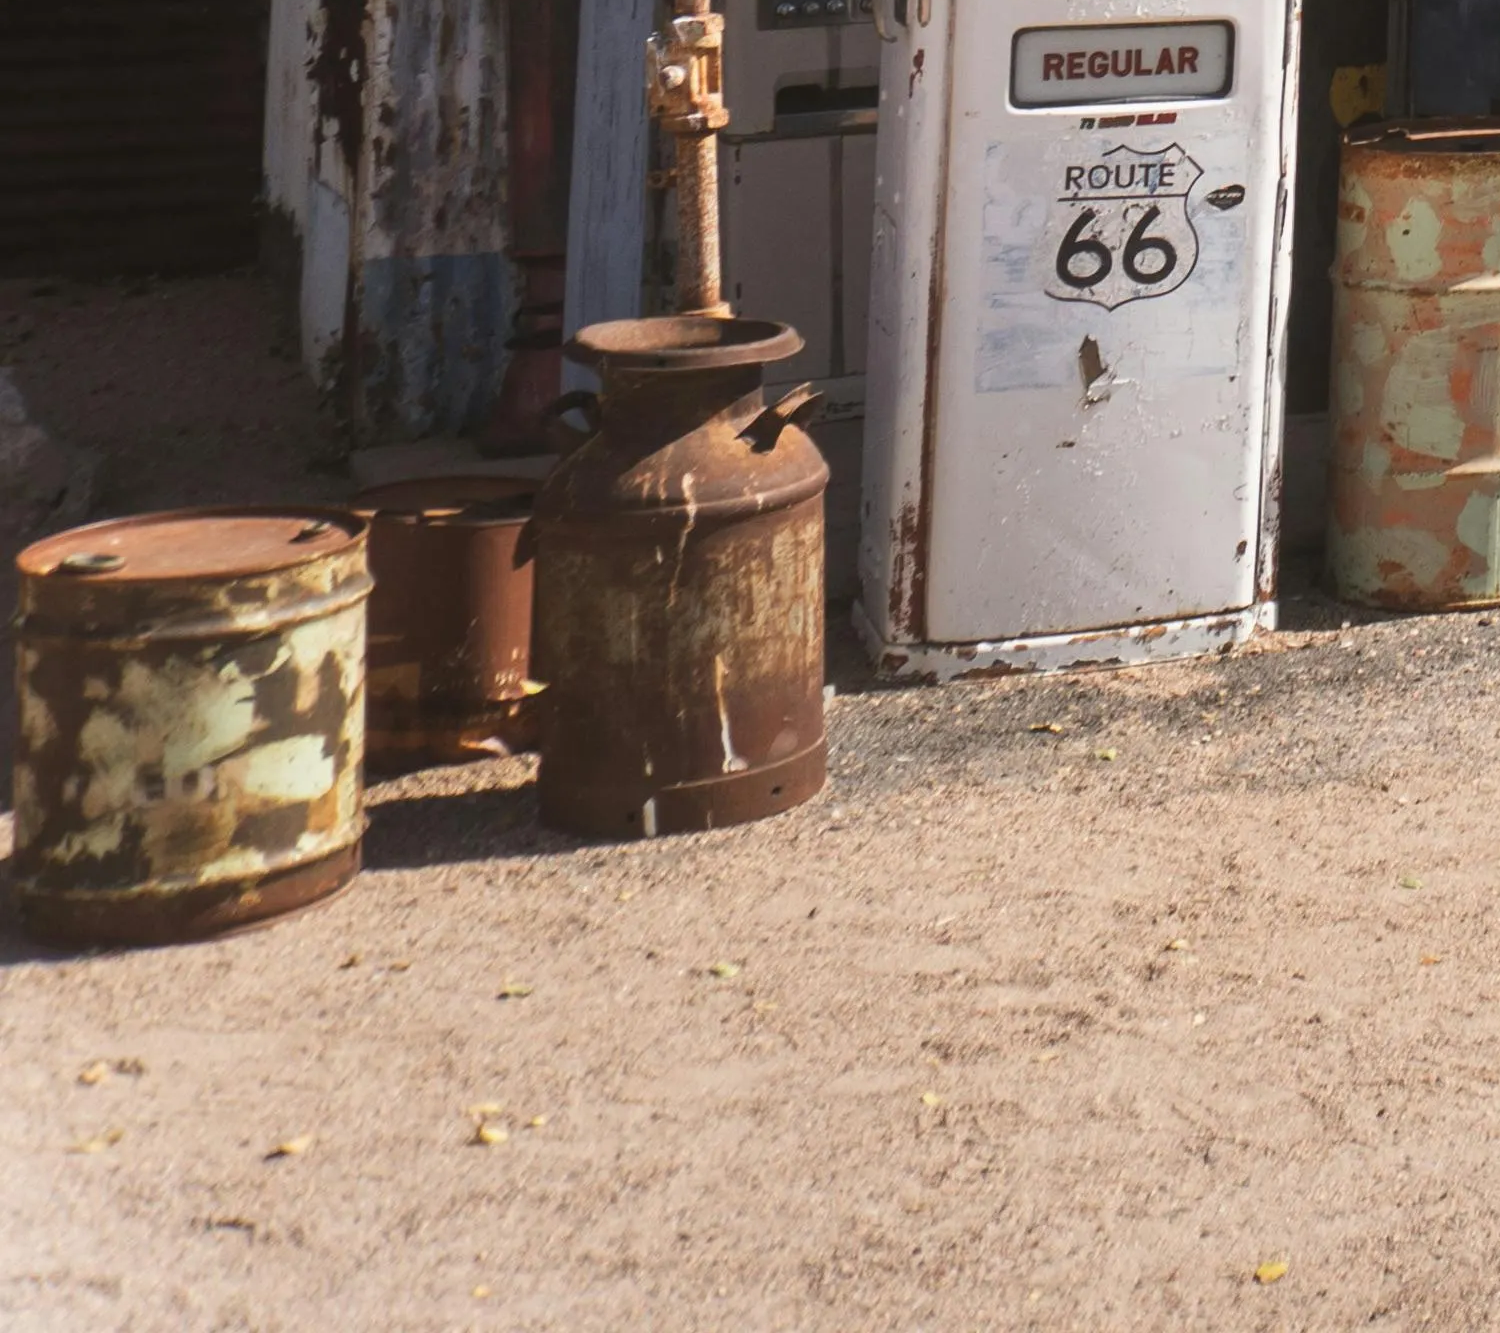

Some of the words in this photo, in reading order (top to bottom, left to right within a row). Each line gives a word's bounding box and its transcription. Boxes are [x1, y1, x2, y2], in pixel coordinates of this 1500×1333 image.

[1041, 45, 1200, 81] REGULAR
[1065, 160, 1176, 191] ROUTE
[1056, 205, 1178, 288] 66
